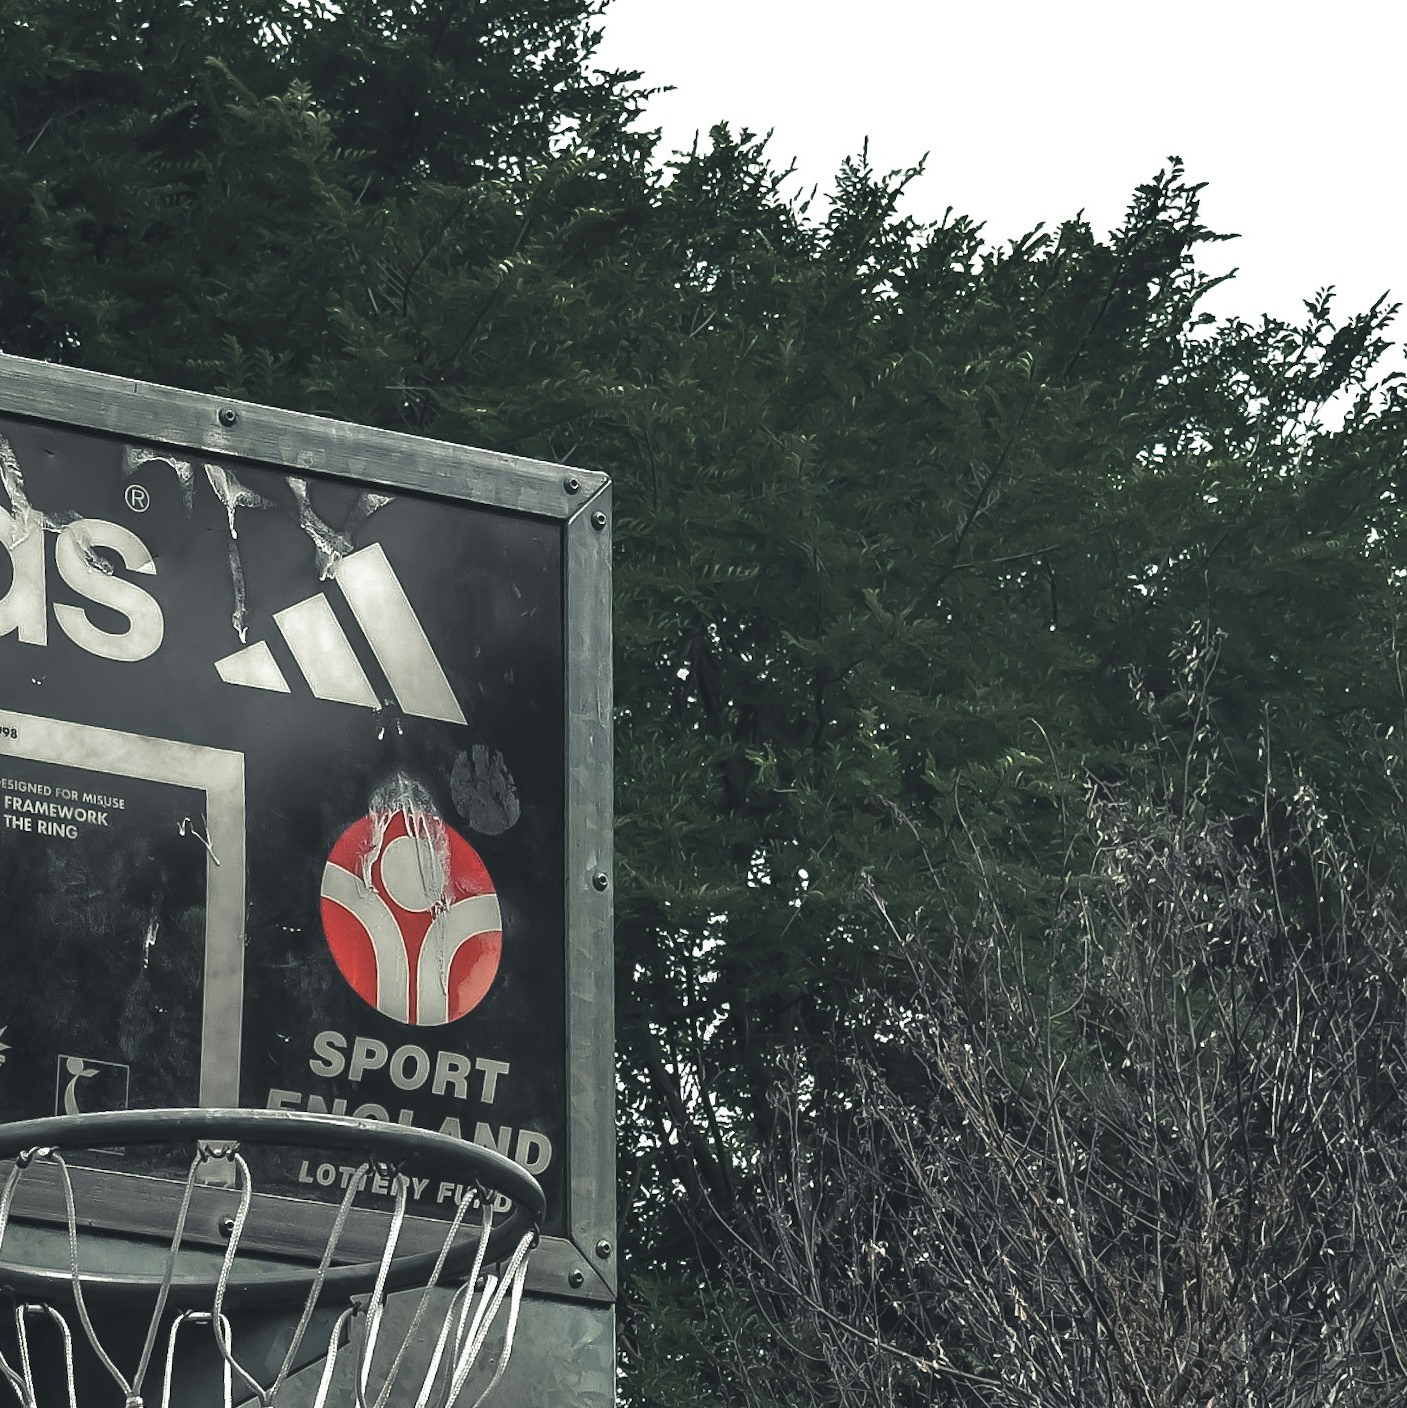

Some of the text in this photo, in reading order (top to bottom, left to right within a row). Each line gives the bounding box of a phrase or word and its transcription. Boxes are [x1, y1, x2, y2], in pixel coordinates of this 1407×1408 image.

[4, 795, 109, 826] FRAMEWORK
[55, 787, 79, 801] FOR
[82, 792, 126, 810] MISUSE
[3, 813, 32, 832] THE
[37, 819, 79, 840] RING
[308, 1030, 511, 1104] SPORT
[437, 1181, 513, 1213] FUD
